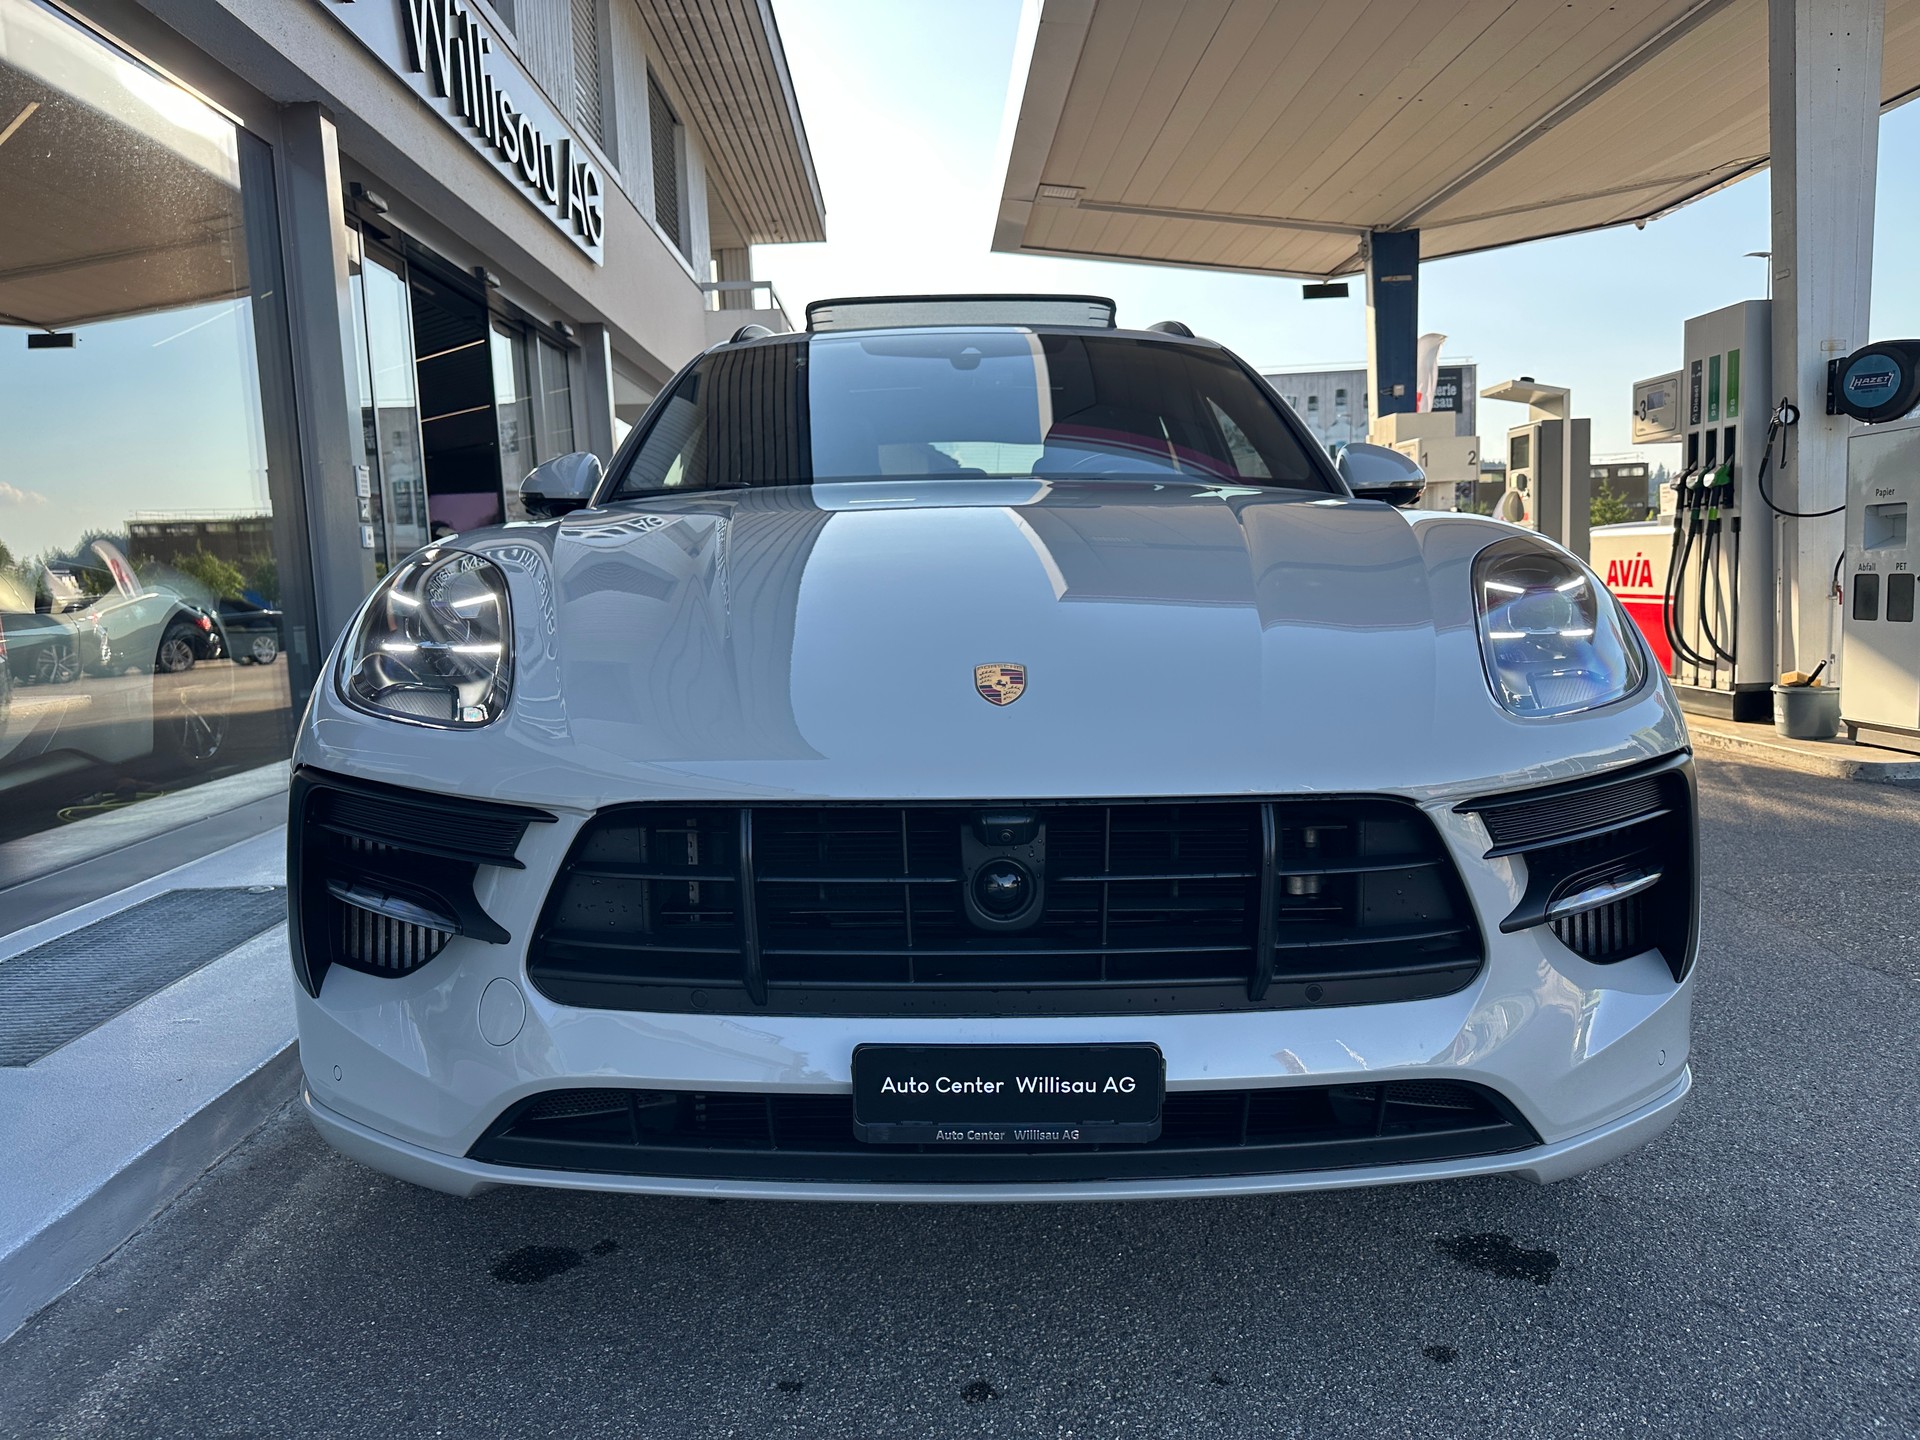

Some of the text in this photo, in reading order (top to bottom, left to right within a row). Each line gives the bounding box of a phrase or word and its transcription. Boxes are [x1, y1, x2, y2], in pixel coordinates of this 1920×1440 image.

[563, 138, 604, 248] AG
[1854, 376, 1890, 387] HAZET
[1640, 400, 1646, 421] 3
[1421, 452, 1428, 467] 1
[1468, 450, 1476, 465] 2
[1875, 487, 1895, 498] Papier
[1857, 562, 1876, 571] Abfall
[1895, 562, 1907, 570] PET
[880, 1076, 1136, 1093] Auto Center Willisau AG
[936, 1129, 1080, 1140] Auto Center Willisau AG
